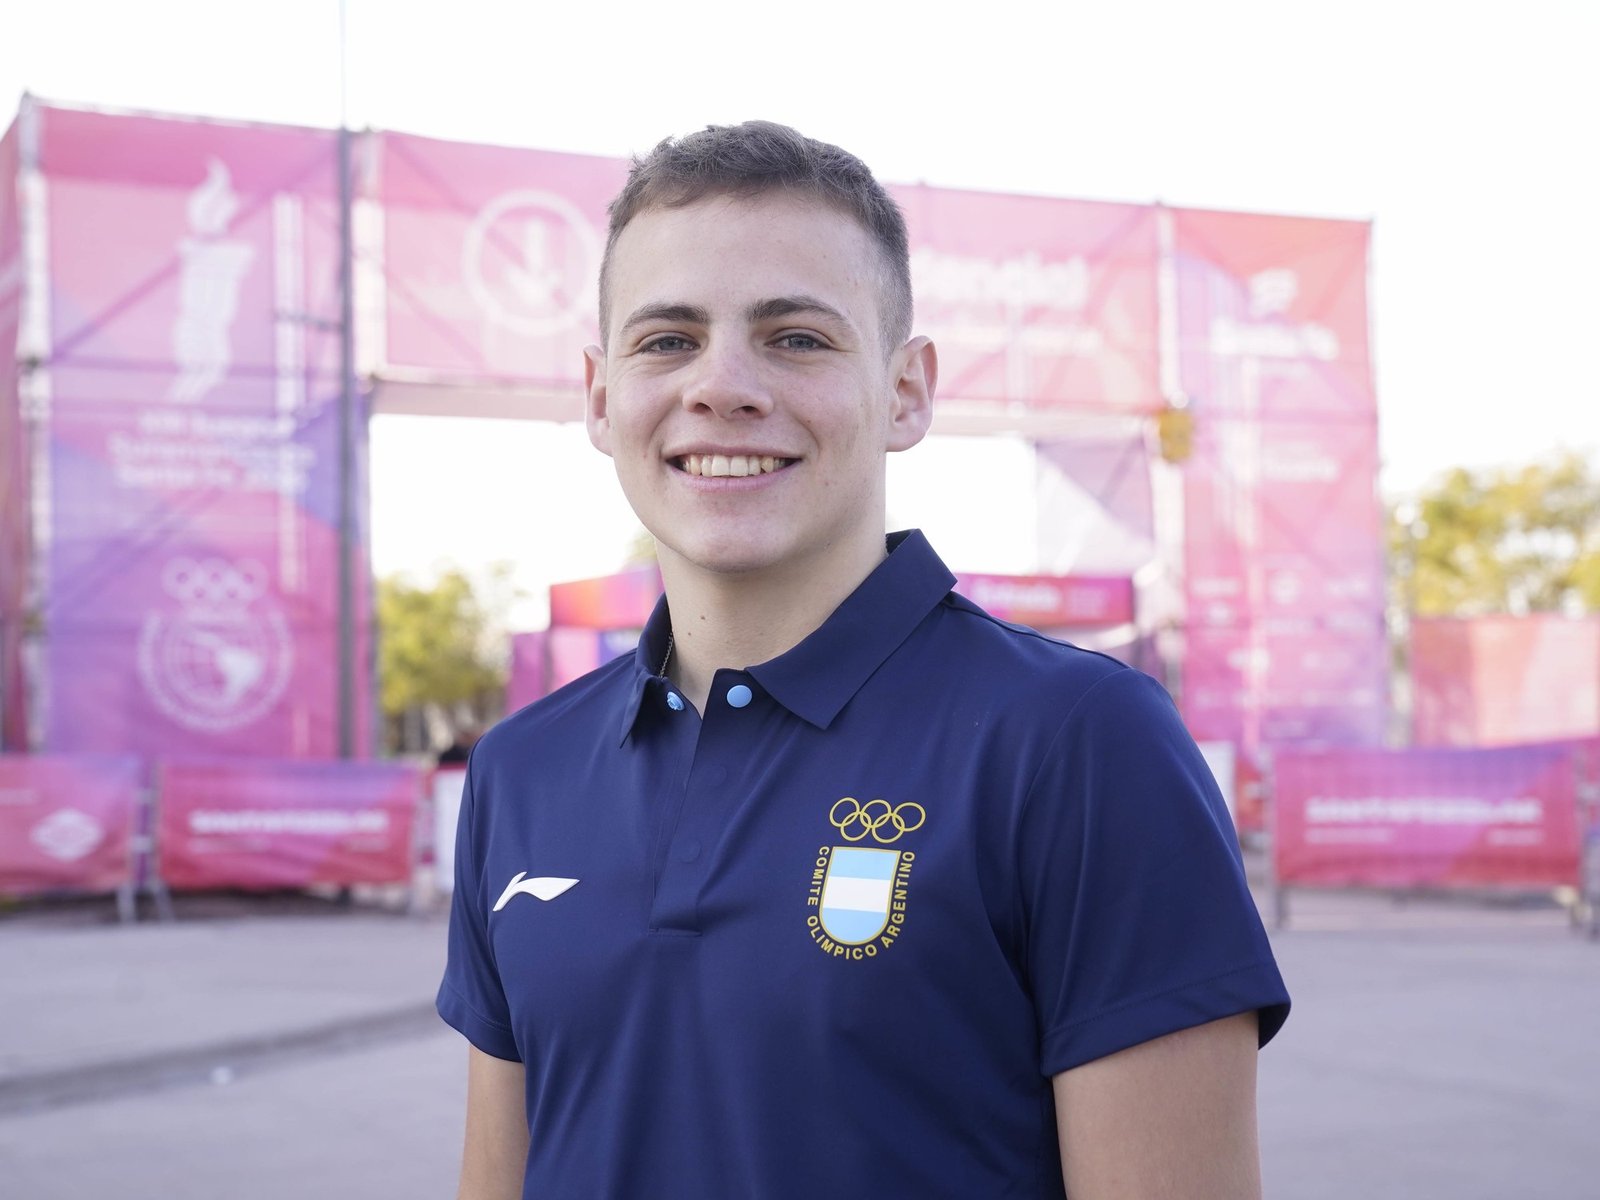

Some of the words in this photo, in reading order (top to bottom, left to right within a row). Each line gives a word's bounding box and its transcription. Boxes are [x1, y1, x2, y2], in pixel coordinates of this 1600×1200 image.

[807, 846, 830, 906] COMITE
[881, 851, 915, 949] ARGENTINO
[807, 915, 877, 960] OLIMPICO
